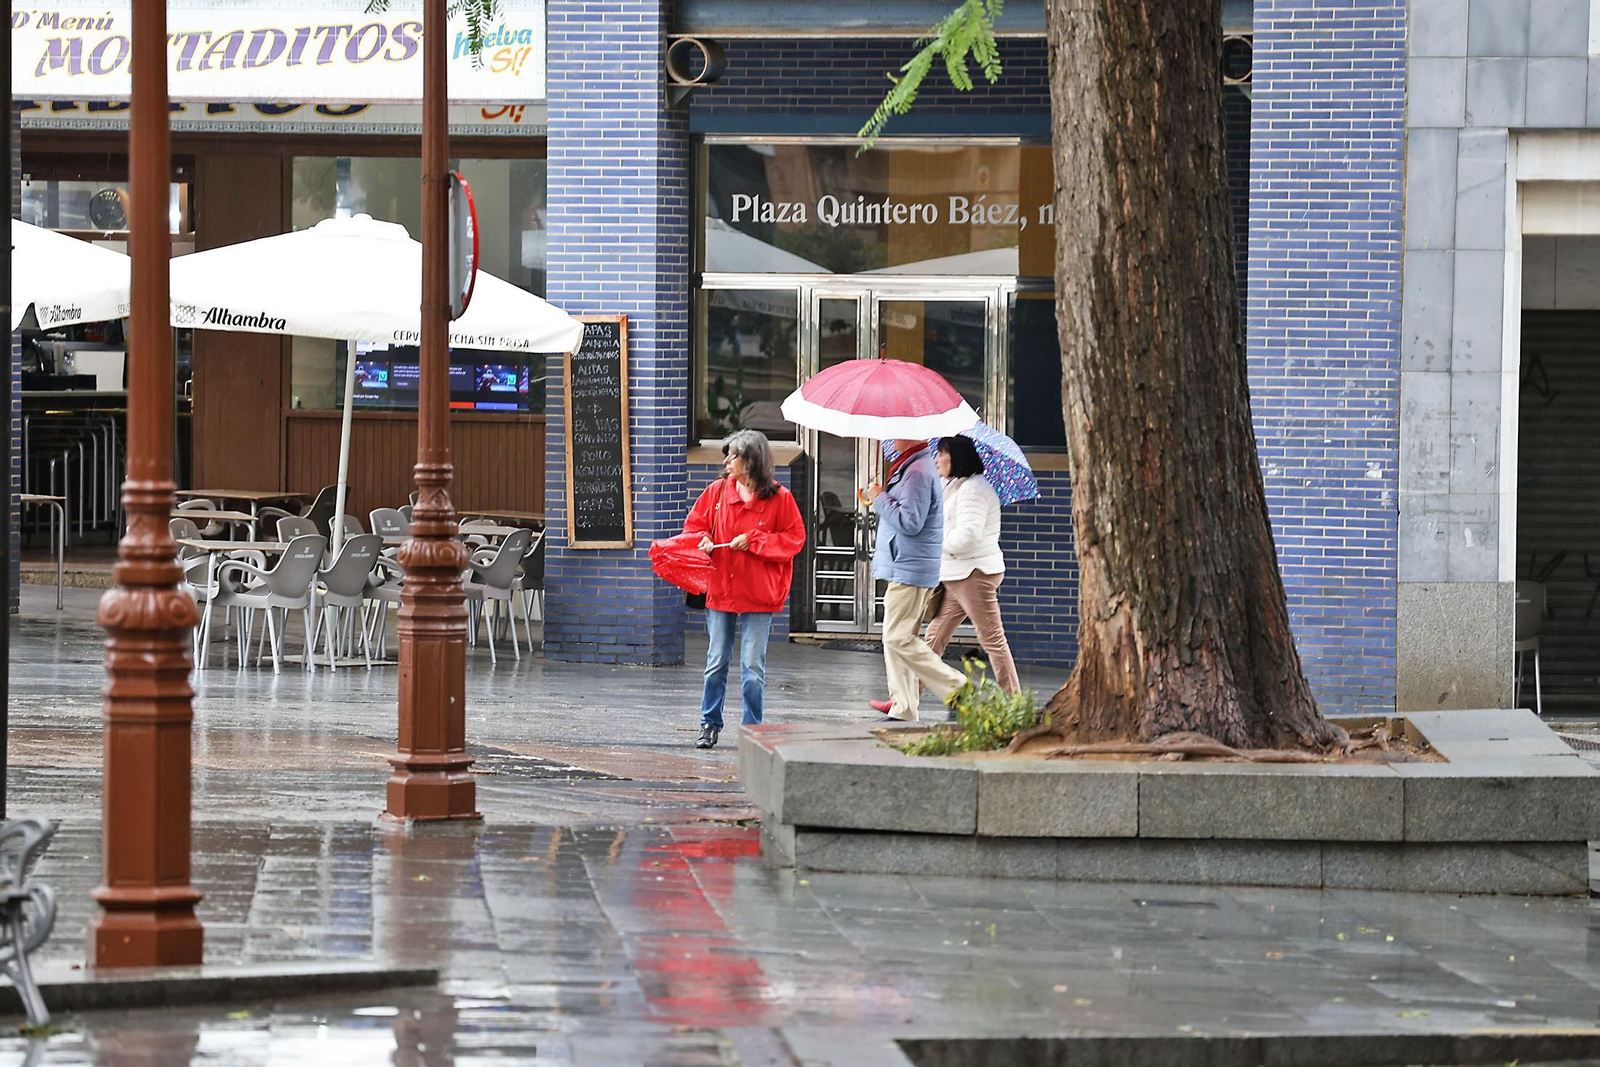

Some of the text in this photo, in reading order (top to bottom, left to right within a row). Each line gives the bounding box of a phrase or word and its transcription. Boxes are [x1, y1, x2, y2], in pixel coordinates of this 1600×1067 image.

[35, 22, 424, 77] MOTADITOS
[731, 193, 807, 223] Plaza
[817, 194, 938, 227] Quintero
[948, 194, 1028, 231] Báez,
[50, 303, 82, 323] Alhambra
[201, 307, 286, 330] Alhambra
[393, 329, 419, 342] CERV
[449, 333, 474, 345] ECHA
[499, 337, 530, 348] PRISA
[584, 325, 612, 338] APAS
